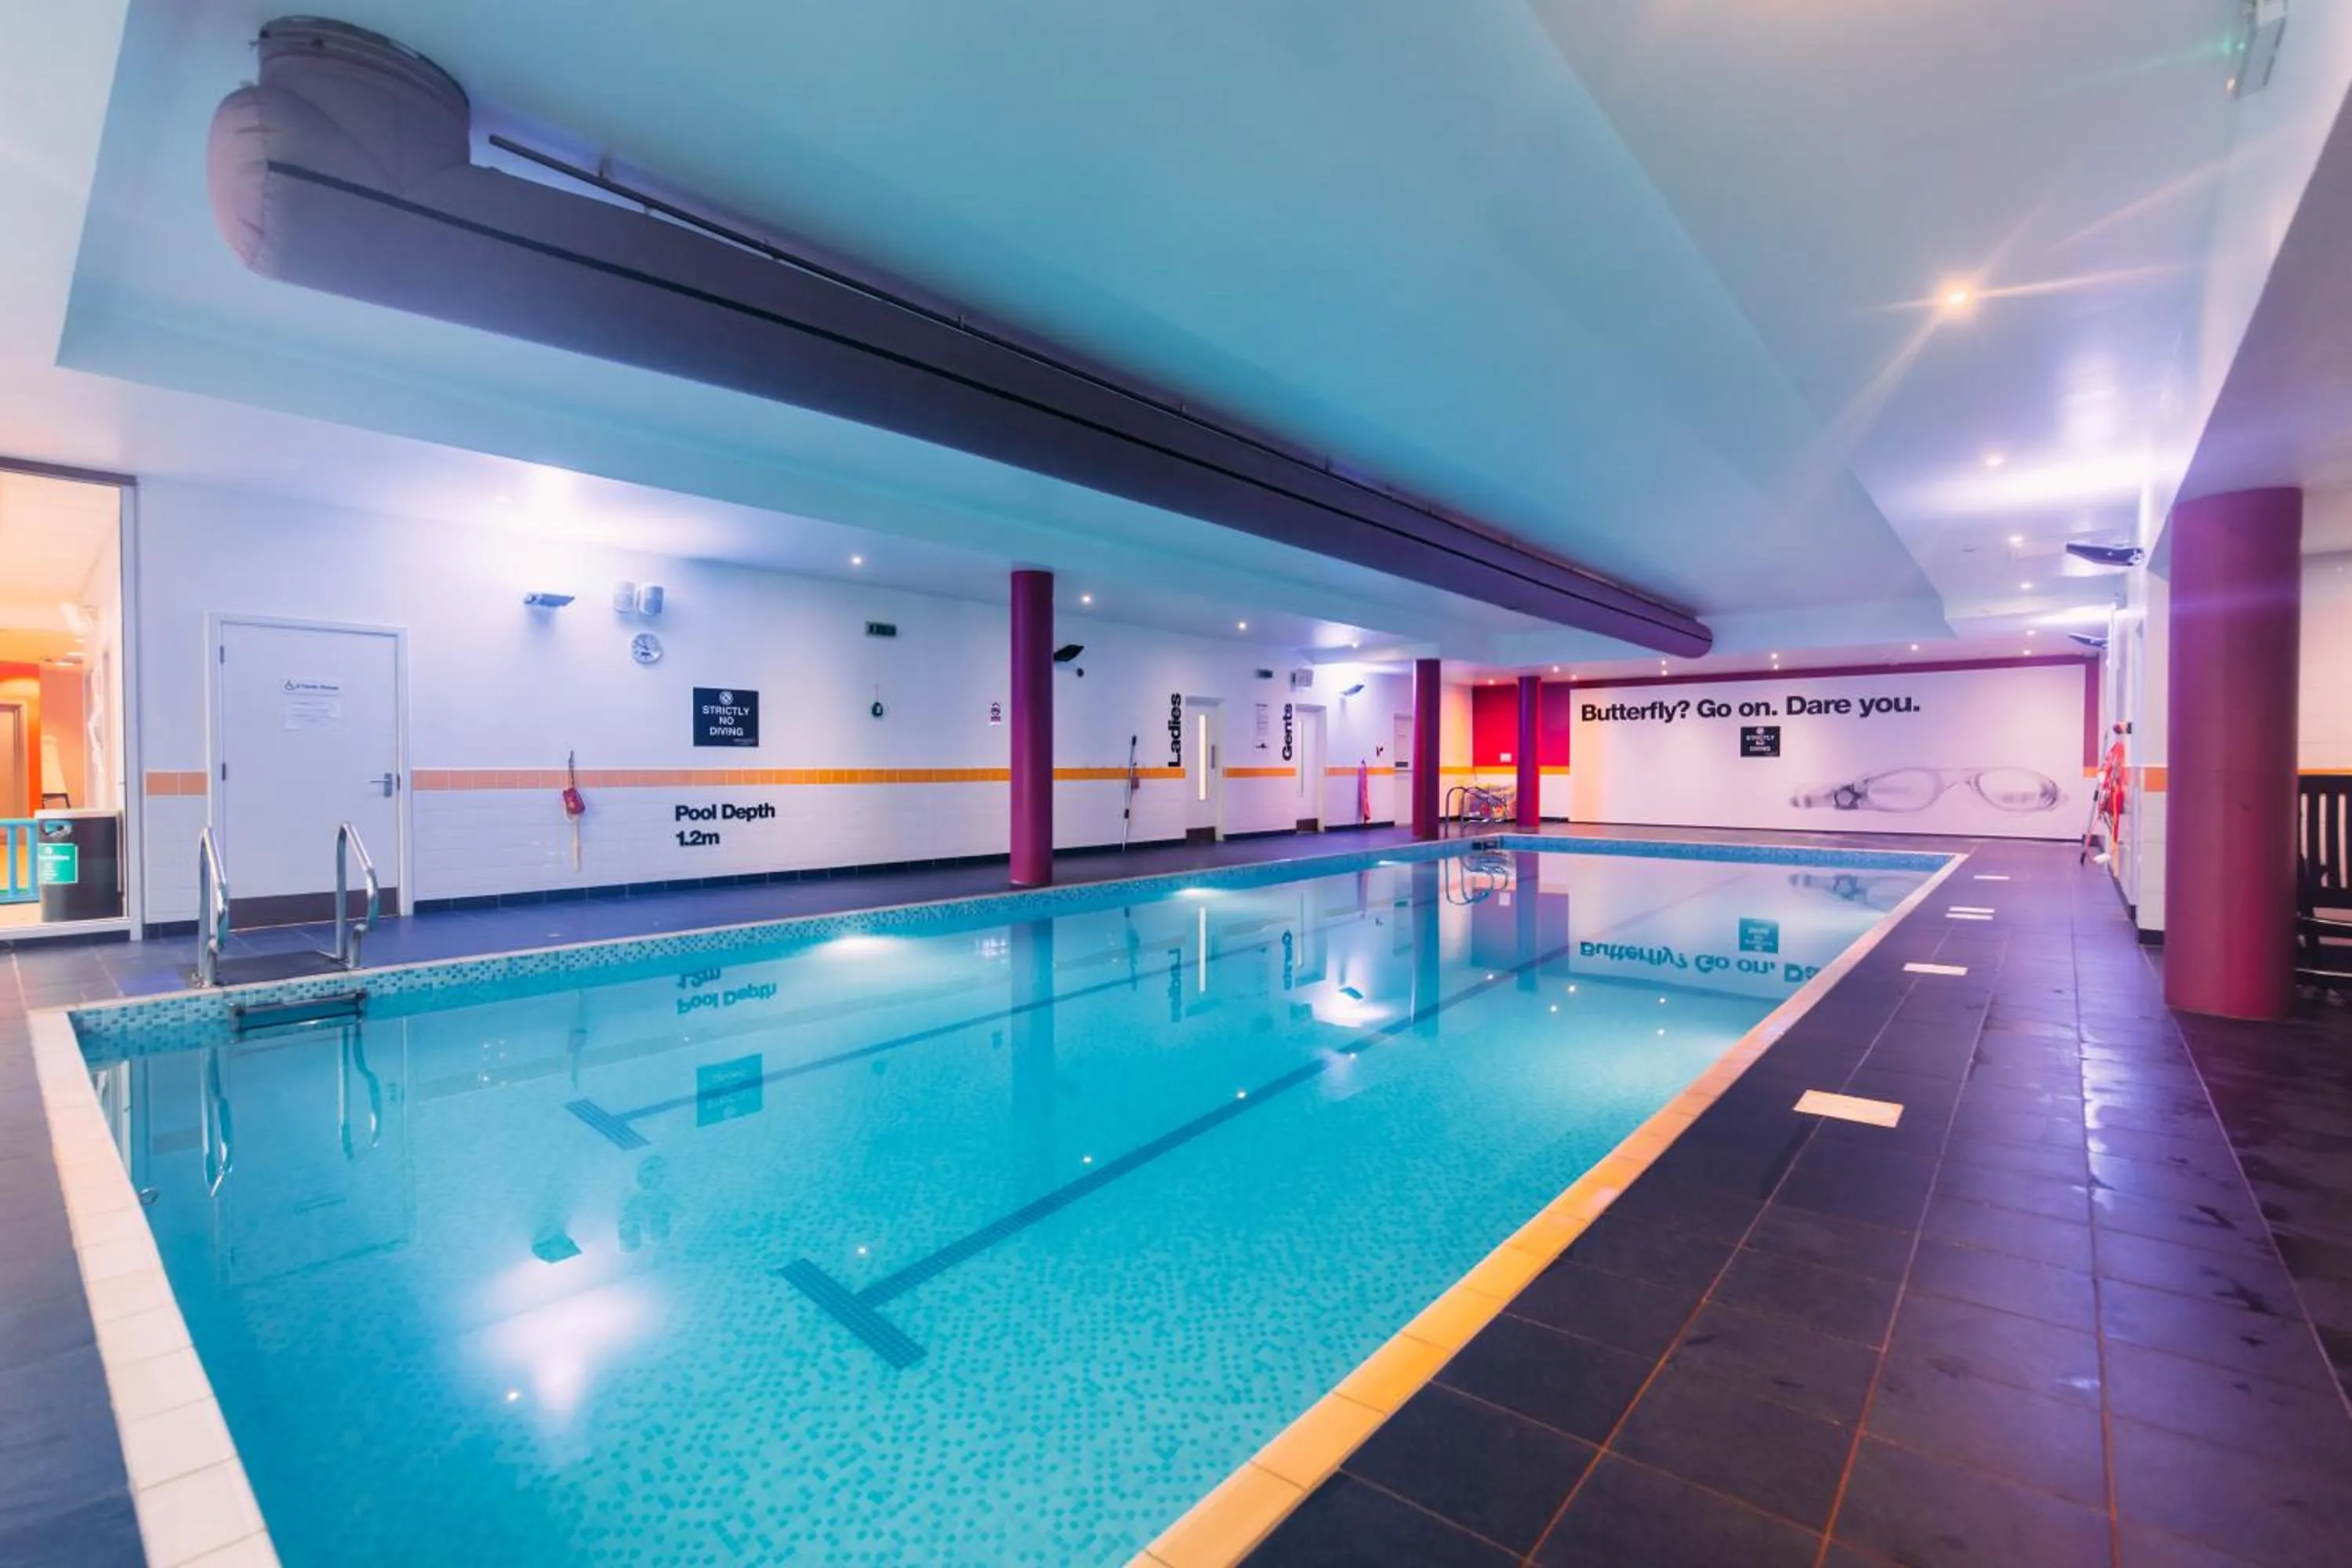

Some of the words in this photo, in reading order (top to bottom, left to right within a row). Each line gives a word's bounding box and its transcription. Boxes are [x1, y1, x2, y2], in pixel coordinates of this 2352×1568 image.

[702, 705, 750, 716] STRICTLY
[1581, 699, 1690, 723] Butterfly?
[1697, 699, 1732, 718] Go
[1738, 701, 1778, 717] on.
[1786, 695, 1851, 716] Dare
[1859, 696, 1920, 718] you.
[719, 716, 735, 725] NO
[710, 727, 744, 736] DIVING
[1167, 692, 1181, 768] Ladies
[1282, 702, 1293, 761] Gents
[675, 804, 717, 822] Pool
[721, 803, 775, 822] Depth
[676, 830, 720, 847] 1.2m
